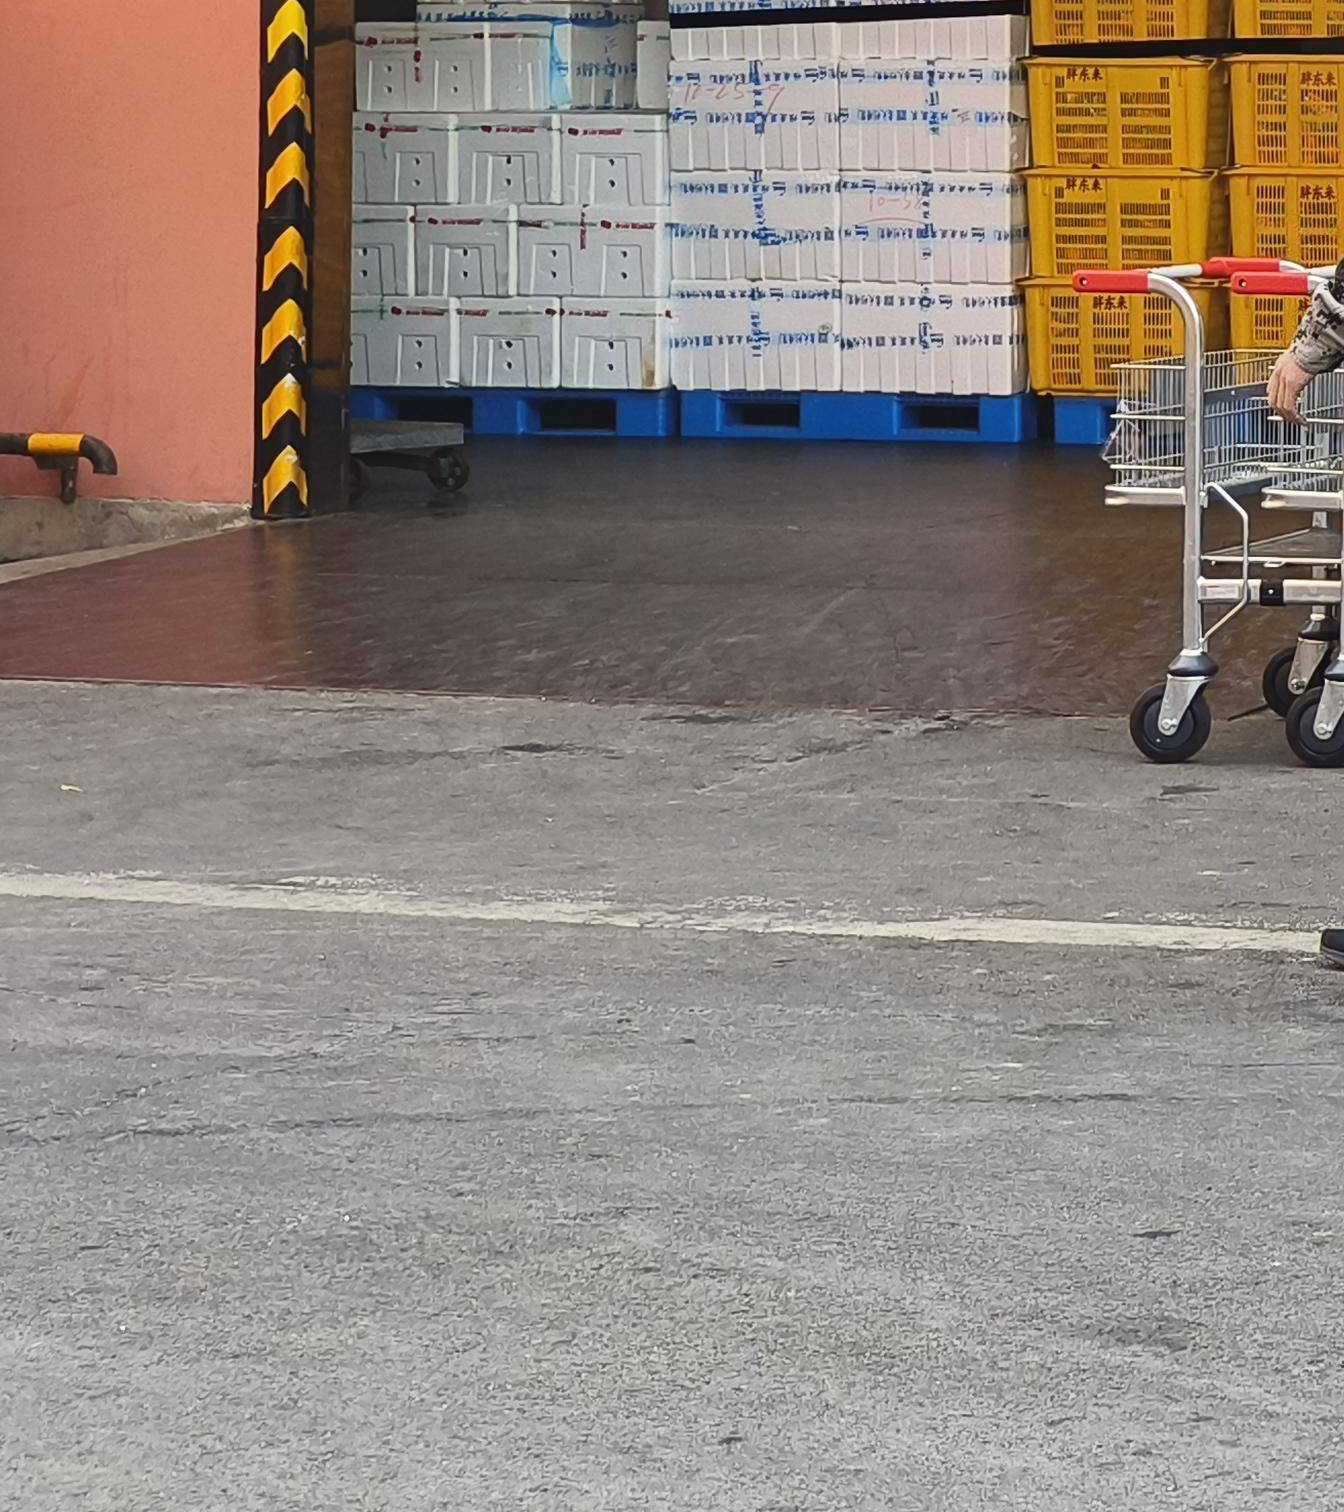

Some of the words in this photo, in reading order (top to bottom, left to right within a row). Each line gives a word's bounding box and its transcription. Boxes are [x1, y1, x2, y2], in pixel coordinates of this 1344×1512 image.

[1066, 67, 1104, 82] 胖东来
[1300, 72, 1337, 86] 胖东来
[1065, 177, 1103, 192] 胖东来
[1299, 186, 1336, 200] 胖东来
[1092, 295, 1128, 310] 胖东来
